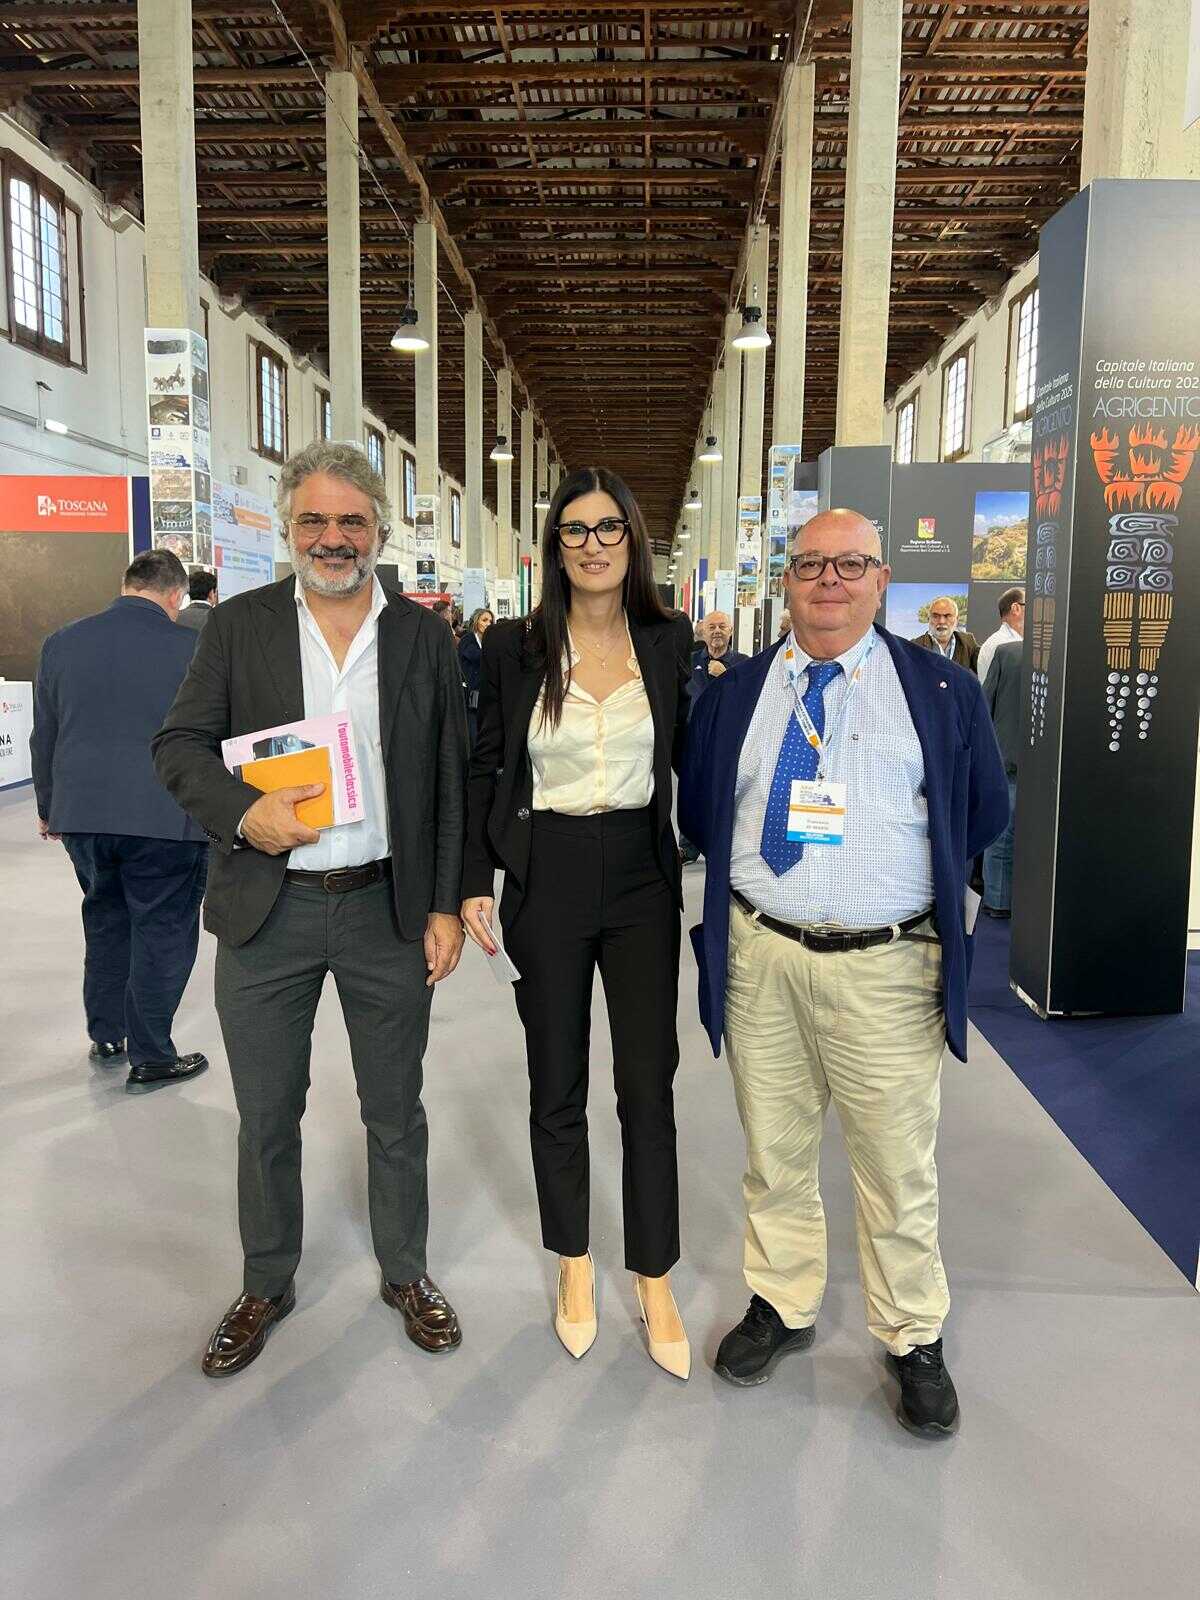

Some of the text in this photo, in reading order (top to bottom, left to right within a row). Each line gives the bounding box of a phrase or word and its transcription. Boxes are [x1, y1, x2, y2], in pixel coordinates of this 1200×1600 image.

[1096, 359, 1195, 375] Capitale Italiana
[1094, 377, 1200, 389] della Cultura 202
[1093, 396, 1200, 418] AGRIGENTO
[58, 499, 108, 511] TOSCANA
